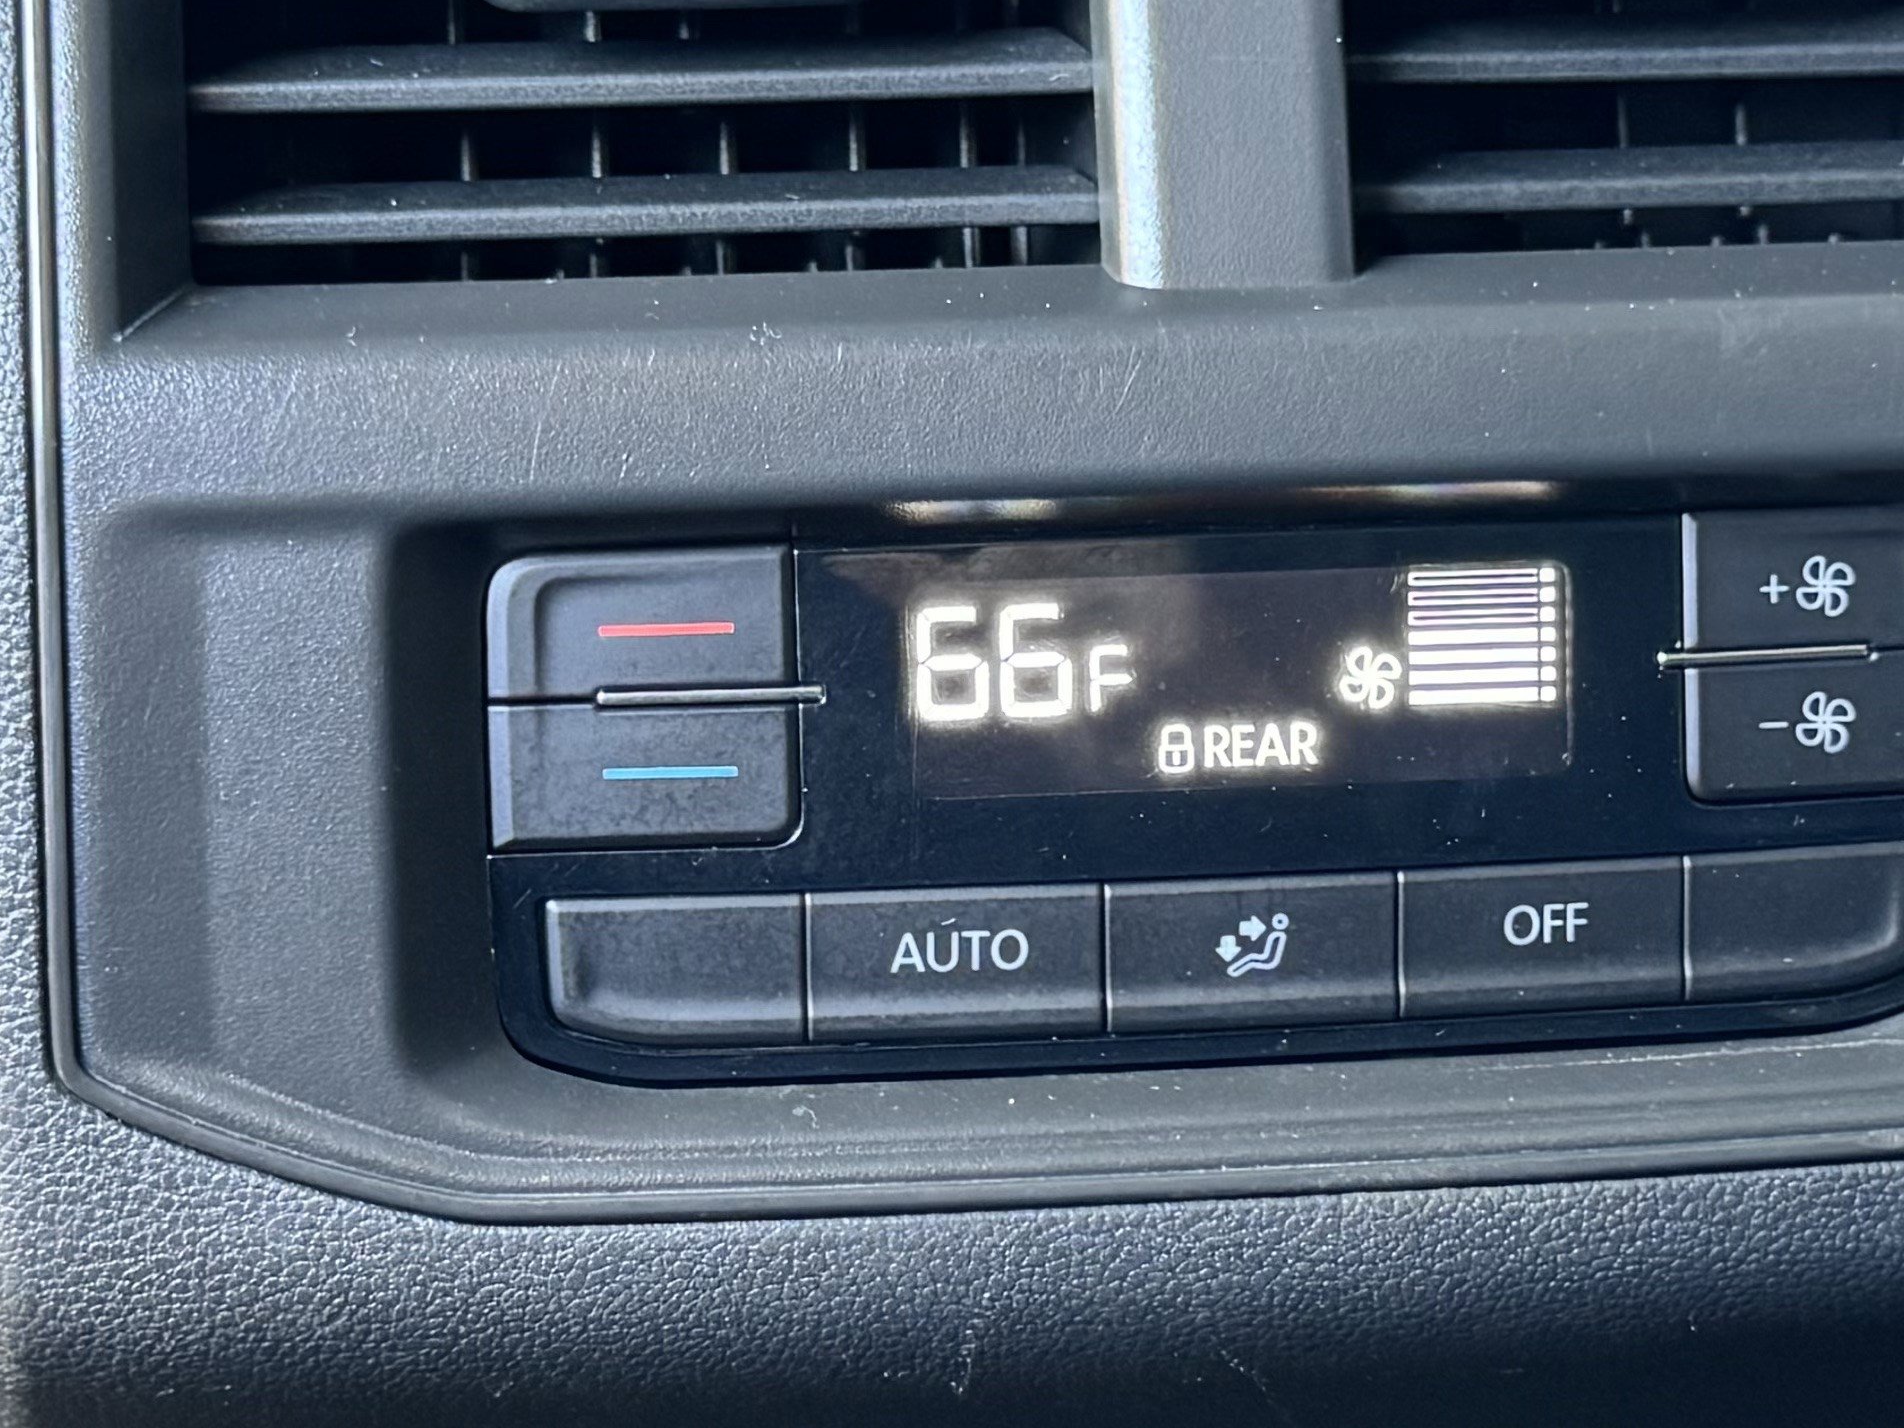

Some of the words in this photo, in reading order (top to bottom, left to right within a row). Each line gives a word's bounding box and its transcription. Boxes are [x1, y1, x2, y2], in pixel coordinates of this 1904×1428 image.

[1203, 720, 1321, 769] REAR
[1503, 902, 1589, 946] OFF
[890, 928, 1029, 973] AUTO
